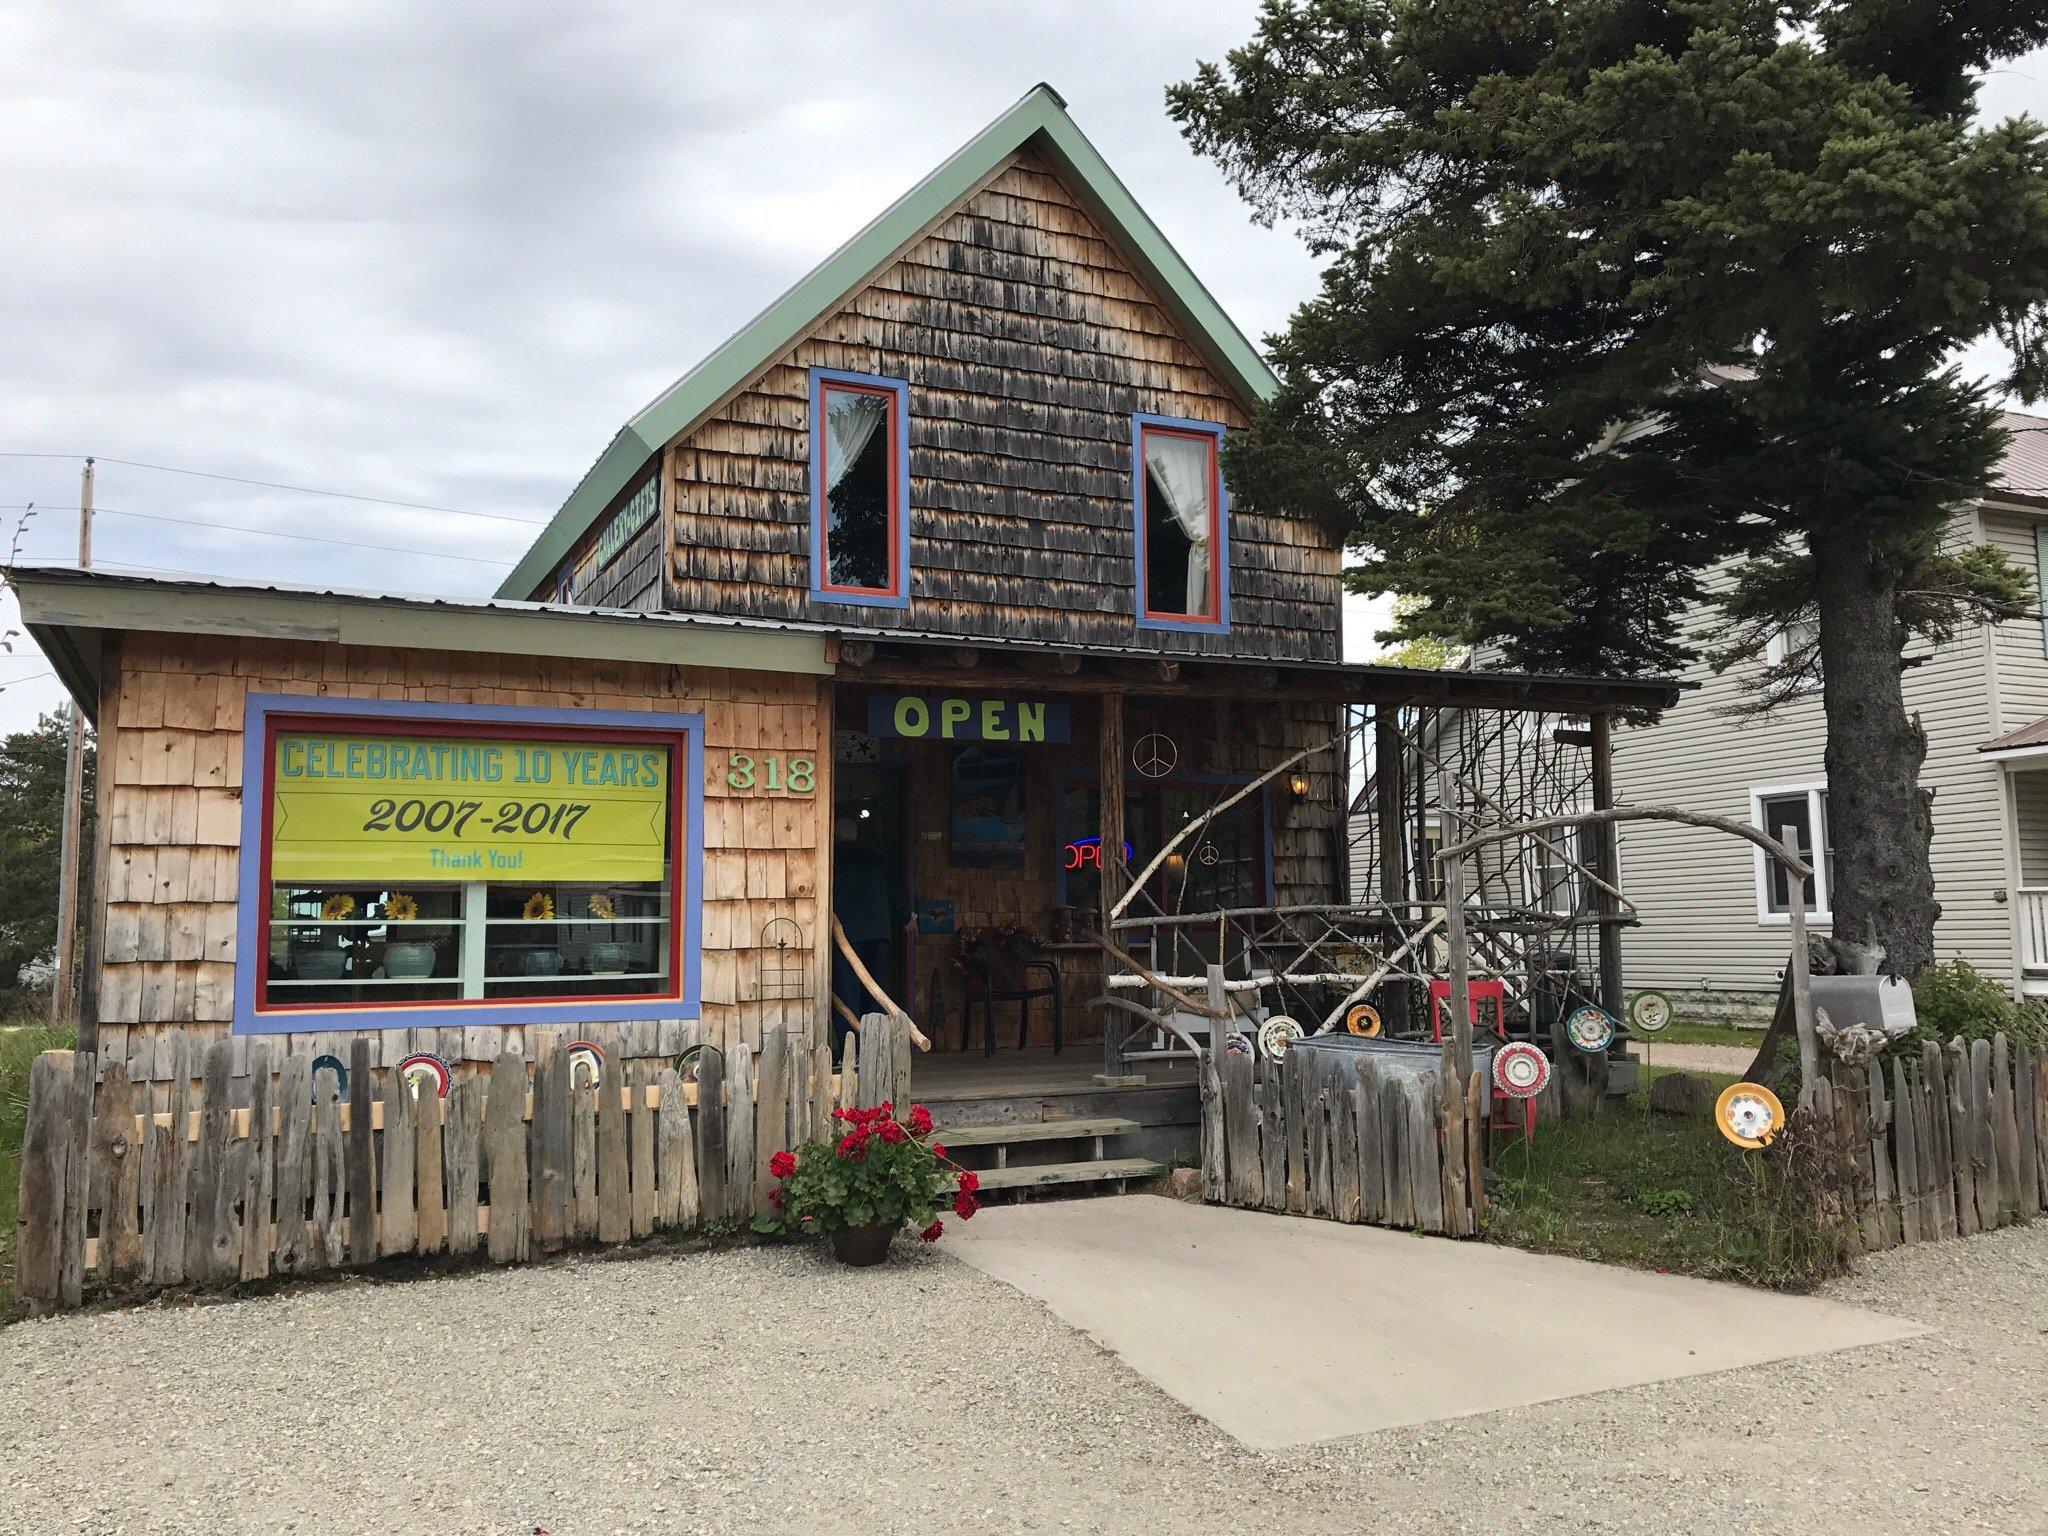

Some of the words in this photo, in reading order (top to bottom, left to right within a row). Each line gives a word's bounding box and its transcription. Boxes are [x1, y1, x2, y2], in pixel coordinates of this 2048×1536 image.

[893, 695, 1047, 742] OPEN
[282, 738, 503, 782] CELEBRATING
[515, 747, 551, 784] 10
[563, 750, 660, 788] YEARS
[726, 755, 816, 793] 318
[363, 798, 592, 840] 2007-2017
[429, 847, 482, 868] Thank
[488, 850, 524, 869] You!
